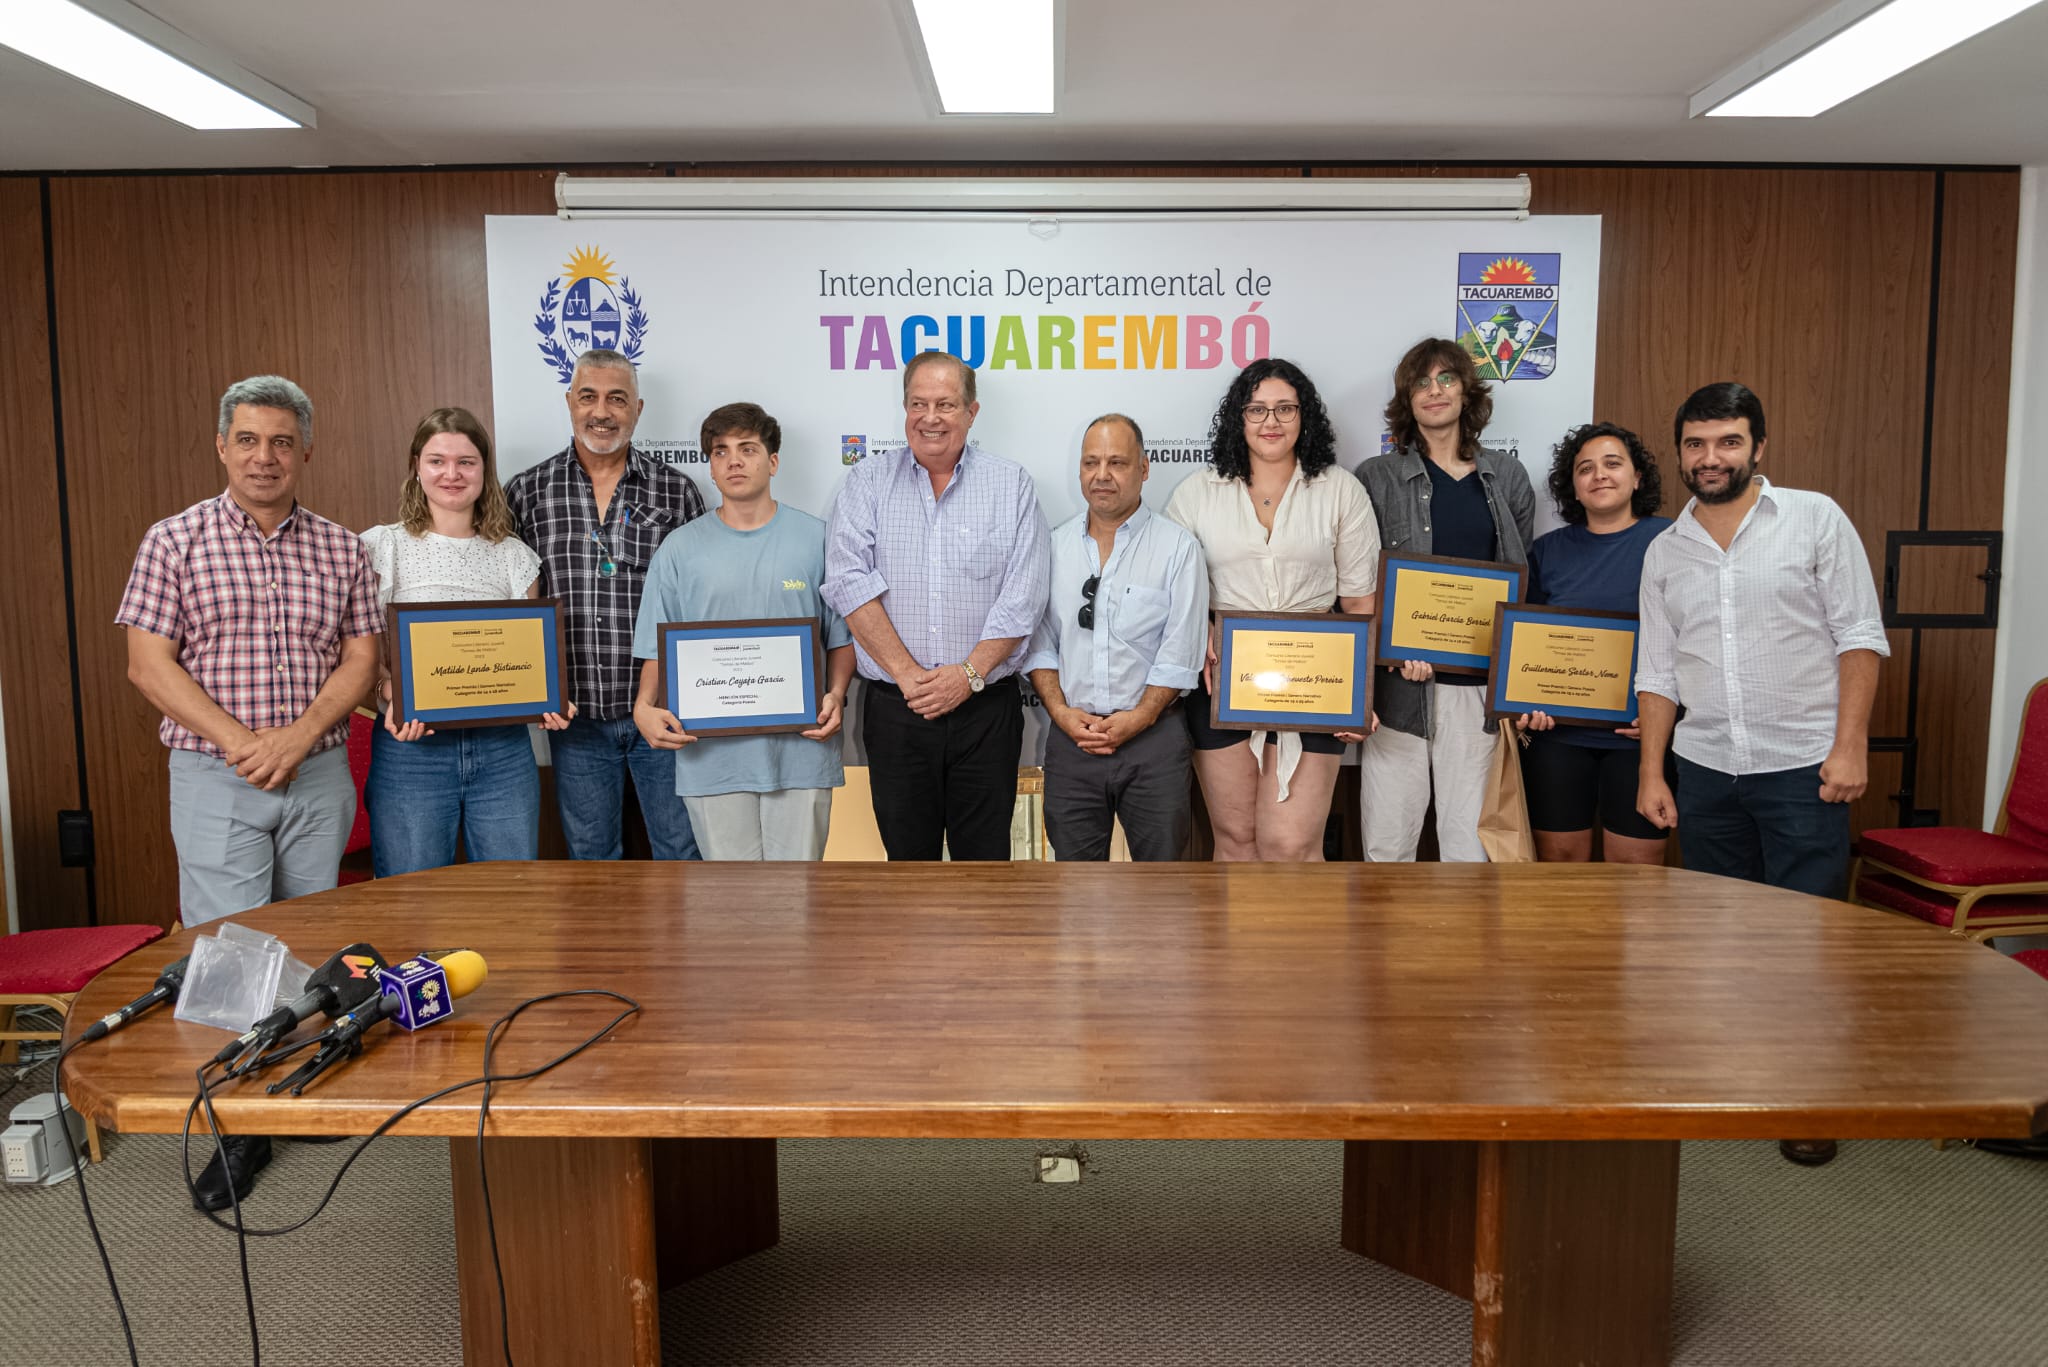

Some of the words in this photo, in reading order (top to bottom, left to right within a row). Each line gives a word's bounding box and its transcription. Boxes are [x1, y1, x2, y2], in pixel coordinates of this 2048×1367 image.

[818, 269, 993, 297] Intendencia
[1005, 268, 1225, 304] Departamental
[1235, 268, 1271, 297] de
[1463, 286, 1554, 299] TACUAREMBÓ
[820, 301, 1271, 370] TACUAREMBÓ
[1143, 438, 1183, 446] ntendencia
[695, 677, 728, 688] Cristian
